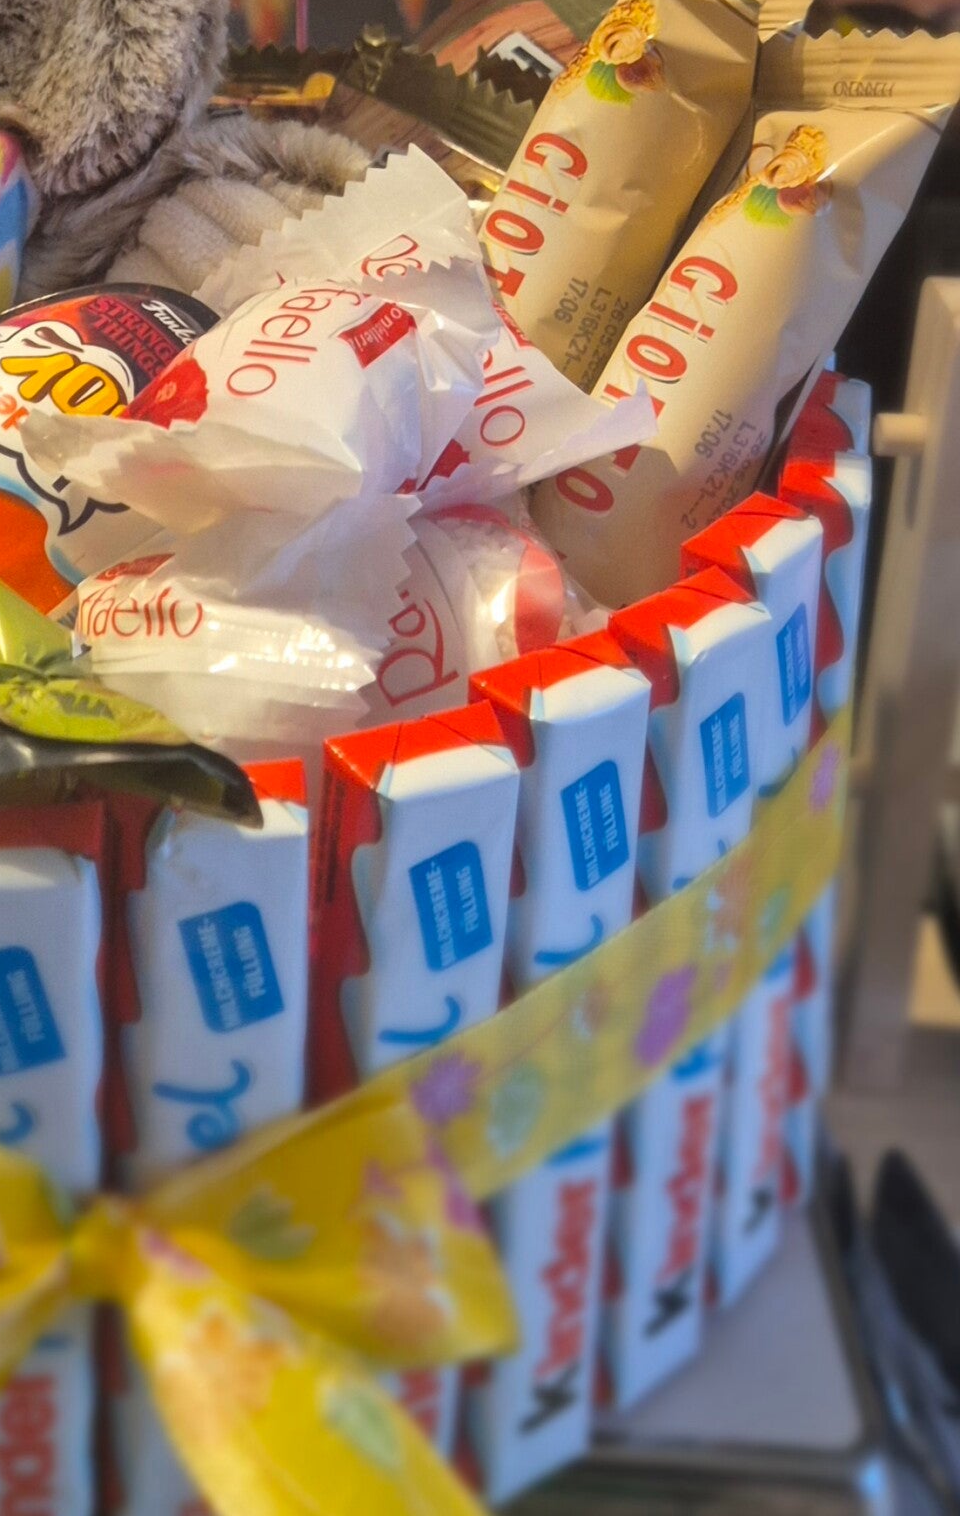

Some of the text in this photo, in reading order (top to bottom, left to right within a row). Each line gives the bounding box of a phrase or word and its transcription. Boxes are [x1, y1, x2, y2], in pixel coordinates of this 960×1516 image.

[553, 275, 590, 325] 17:06
[86, 295, 178, 366] STRANG
[694, 408, 734, 459] 17:06
